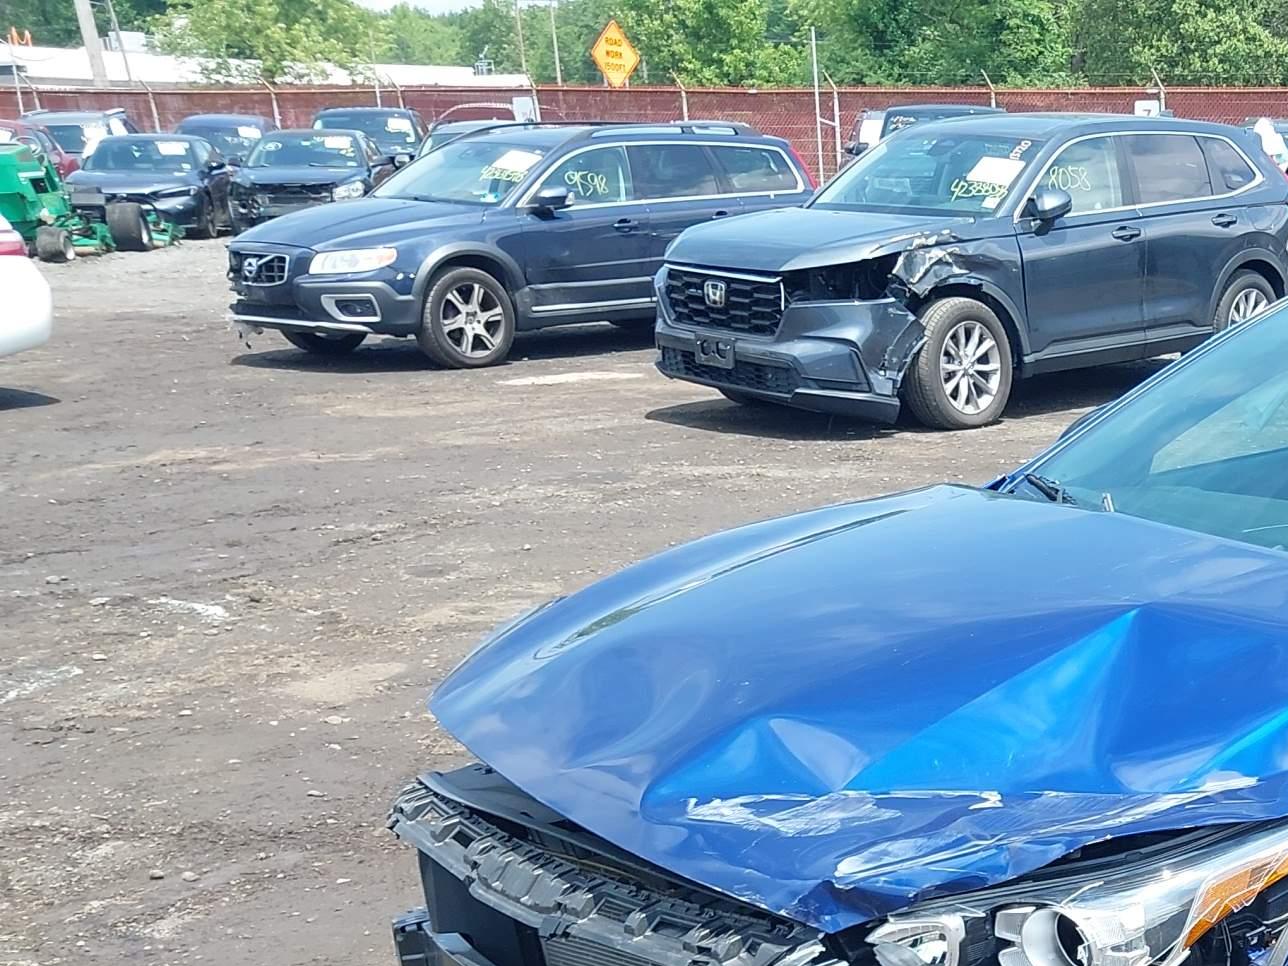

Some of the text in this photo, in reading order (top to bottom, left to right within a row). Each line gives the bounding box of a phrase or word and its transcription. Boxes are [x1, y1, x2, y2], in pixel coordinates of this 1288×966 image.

[605, 36, 623, 47] ROAD
[564, 170, 609, 196] 9598
[1049, 166, 1091, 191] 8058
